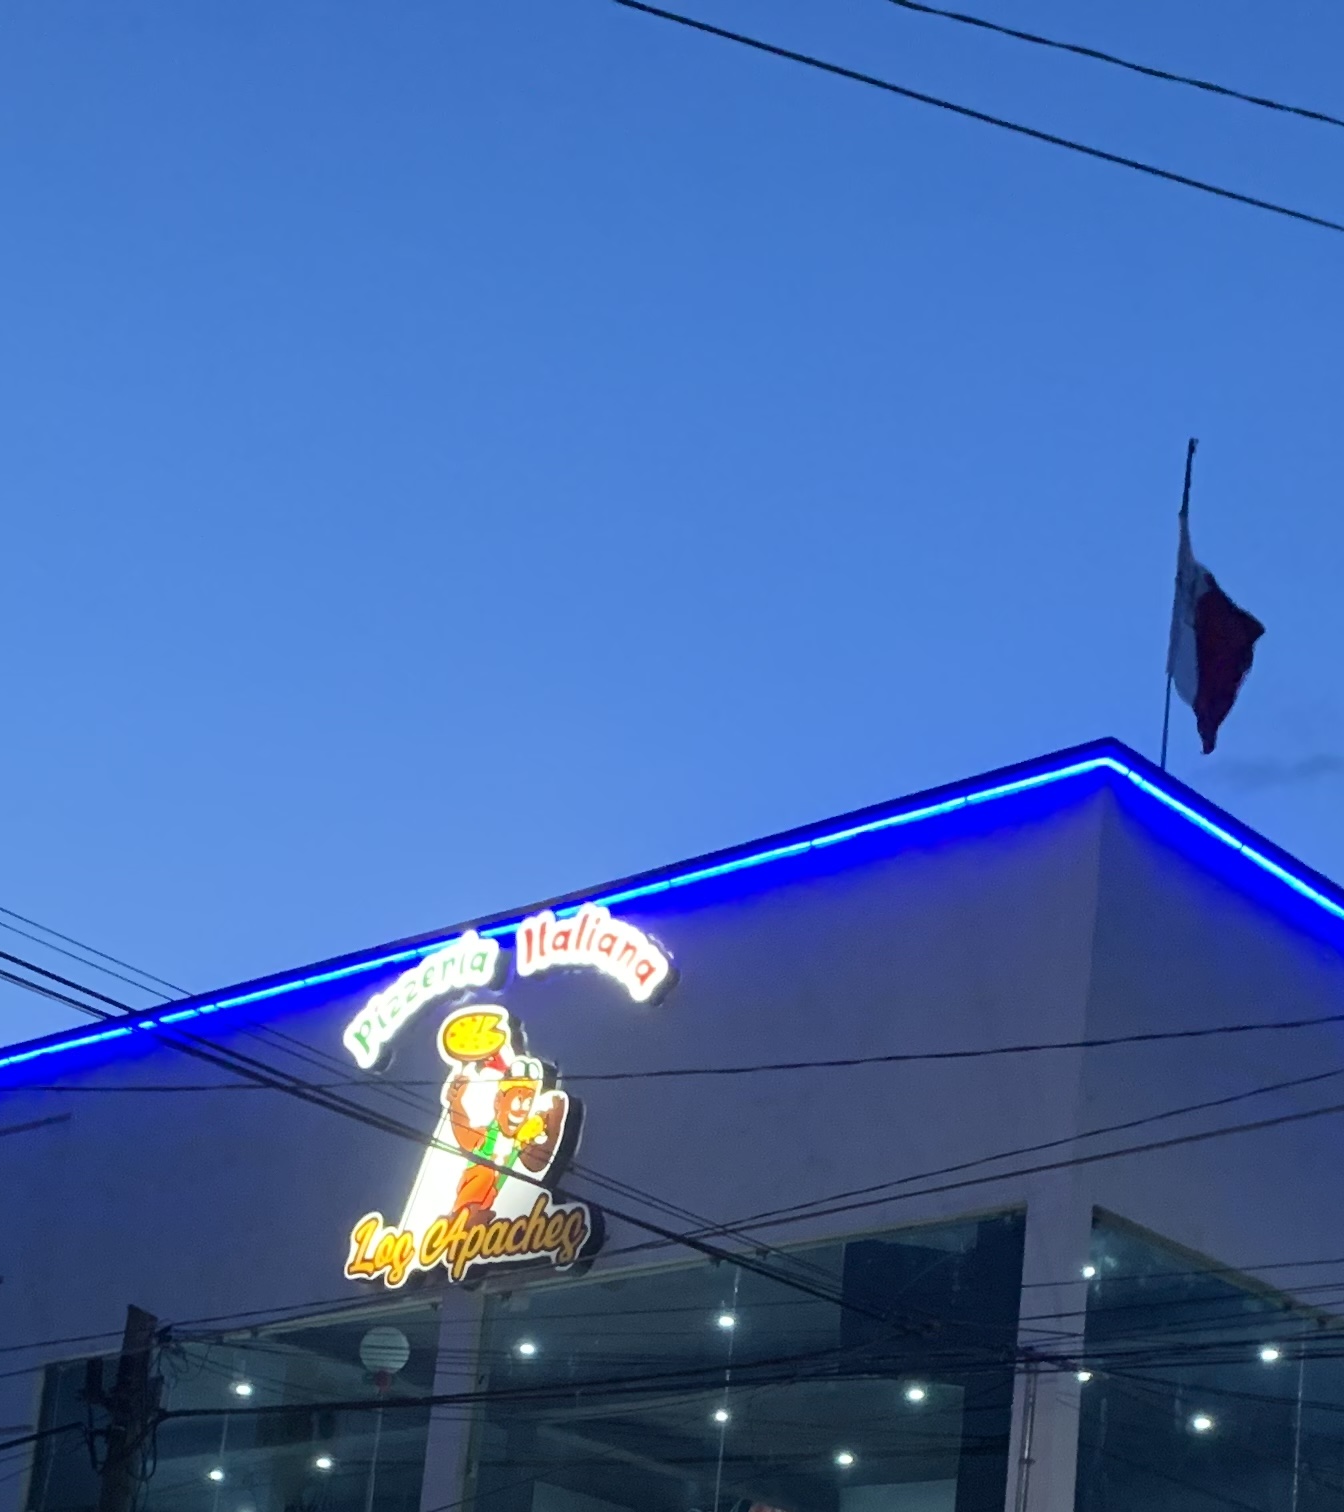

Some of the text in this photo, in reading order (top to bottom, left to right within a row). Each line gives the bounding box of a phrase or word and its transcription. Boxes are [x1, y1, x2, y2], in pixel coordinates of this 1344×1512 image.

[524, 912, 657, 987] Italiana
[346, 1191, 589, 1286] Los Apaches
